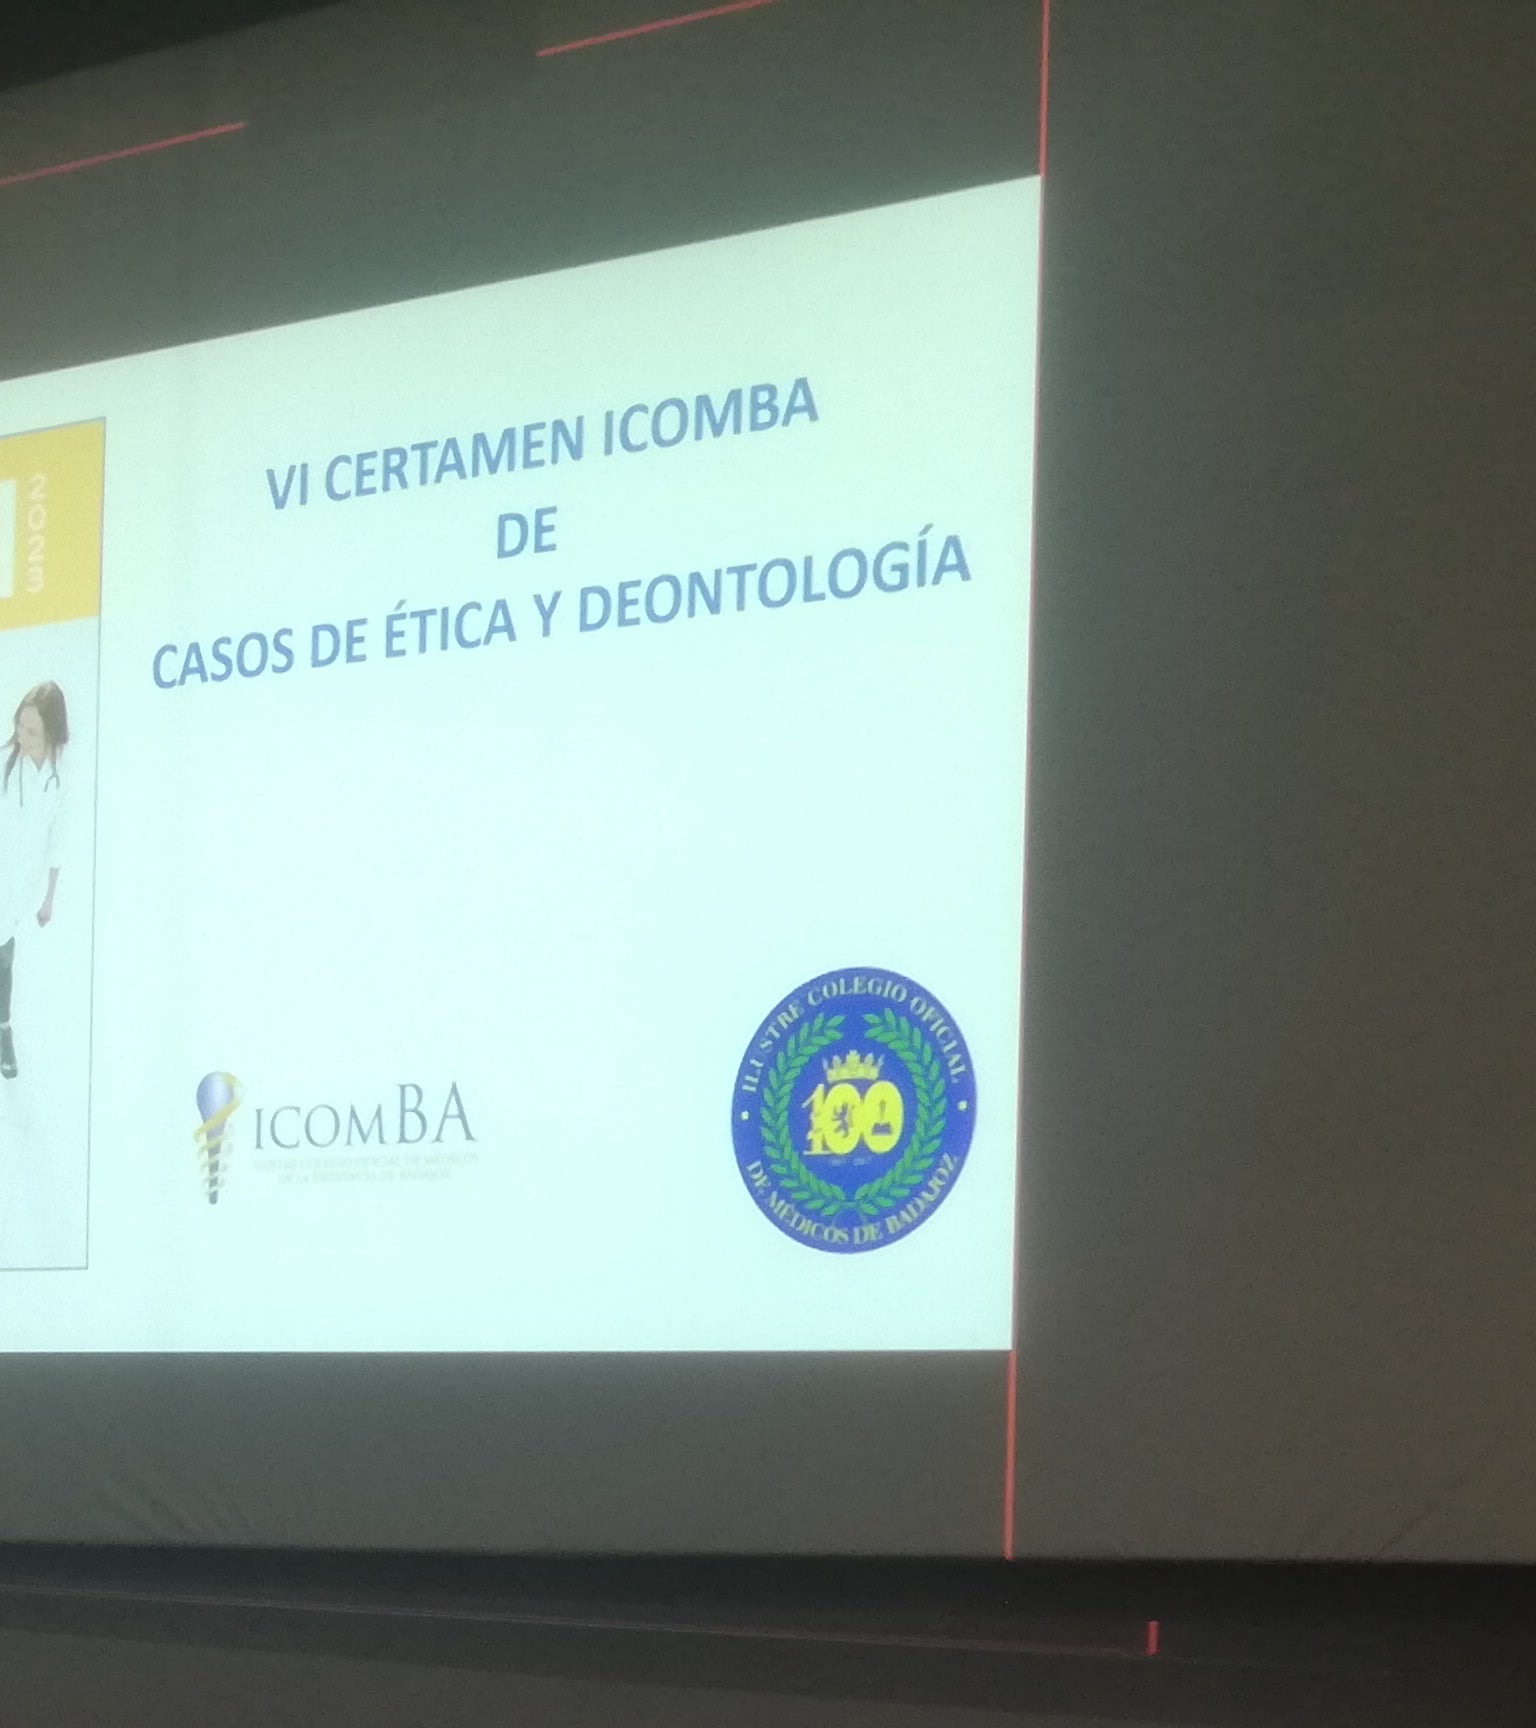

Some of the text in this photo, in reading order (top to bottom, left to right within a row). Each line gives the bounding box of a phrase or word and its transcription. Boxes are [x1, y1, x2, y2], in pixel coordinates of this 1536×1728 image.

[265, 376, 820, 511] VI CERTAMEN ICOMBA
[495, 506, 559, 560] DE
[151, 522, 972, 690] CASOS DE ÉTICA Y DEONTOLOGÍA
[806, 975, 908, 1007] COLEGIO
[910, 995, 966, 1084] OFICIAL
[746, 1160, 772, 1195] DE
[768, 1190, 850, 1245] MÉDICOS
[852, 1223, 884, 1246] DE
